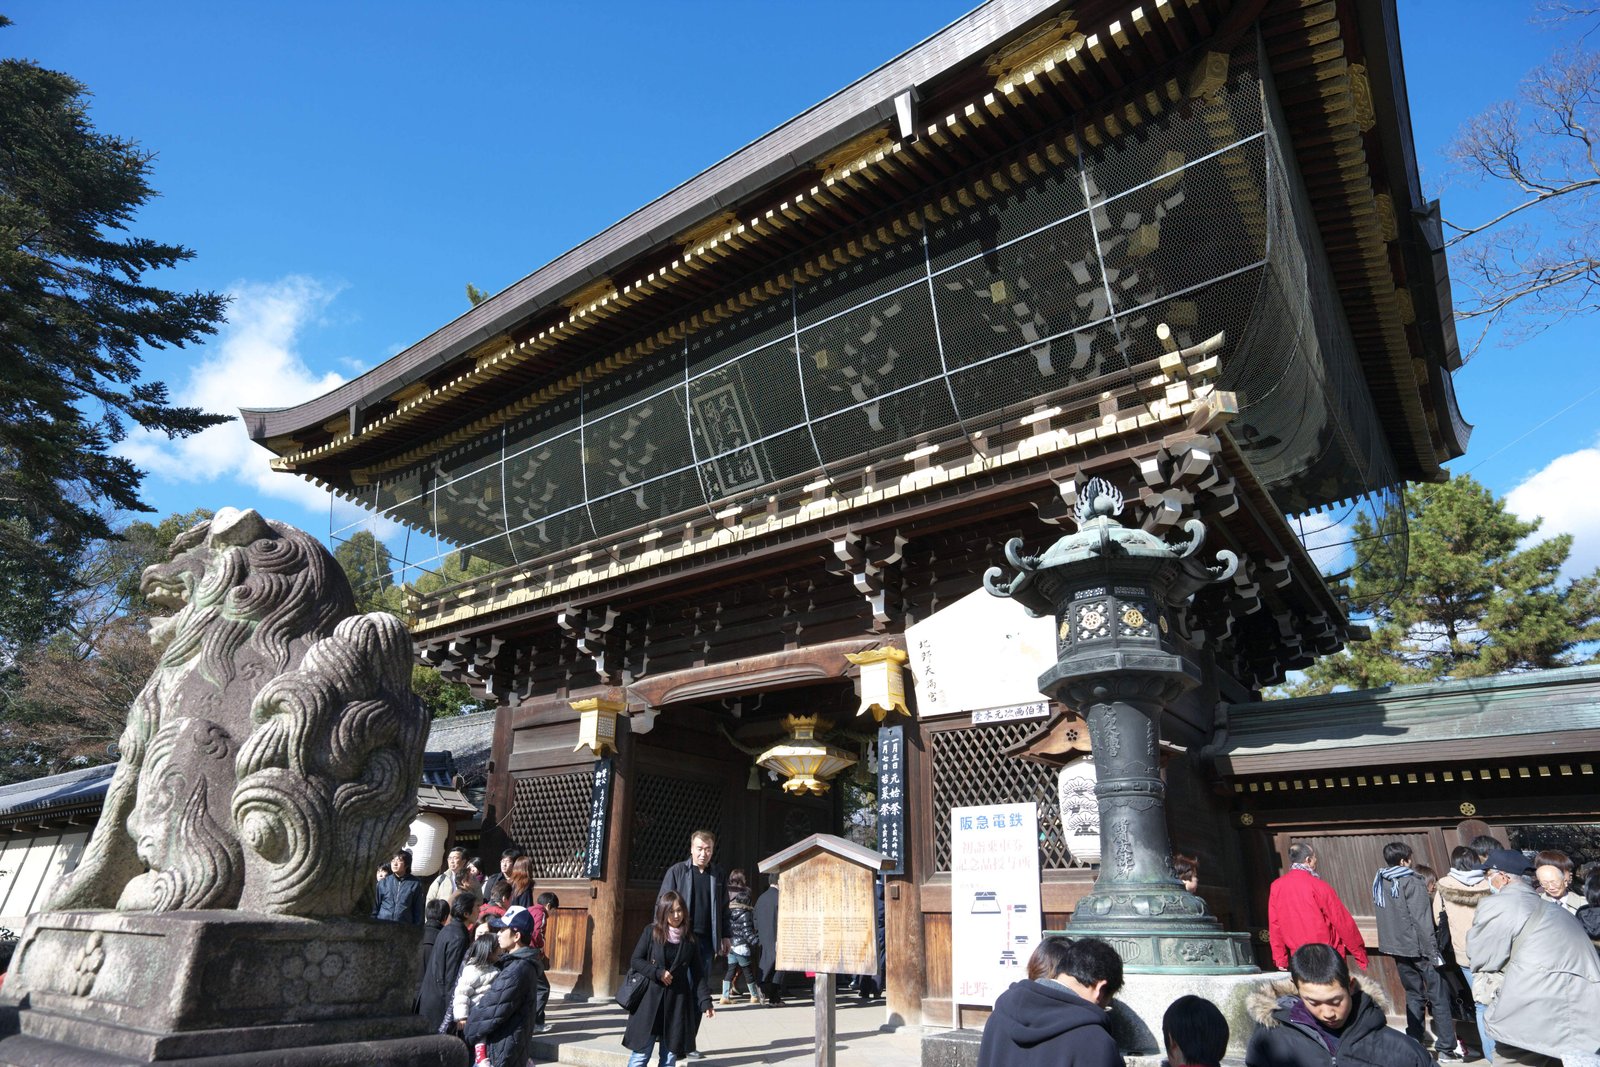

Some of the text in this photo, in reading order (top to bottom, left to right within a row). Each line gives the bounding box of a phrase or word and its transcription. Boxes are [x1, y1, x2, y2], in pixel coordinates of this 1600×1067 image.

[960, 812, 1024, 831] 阪急電鉄
[959, 980, 992, 998] 北野
